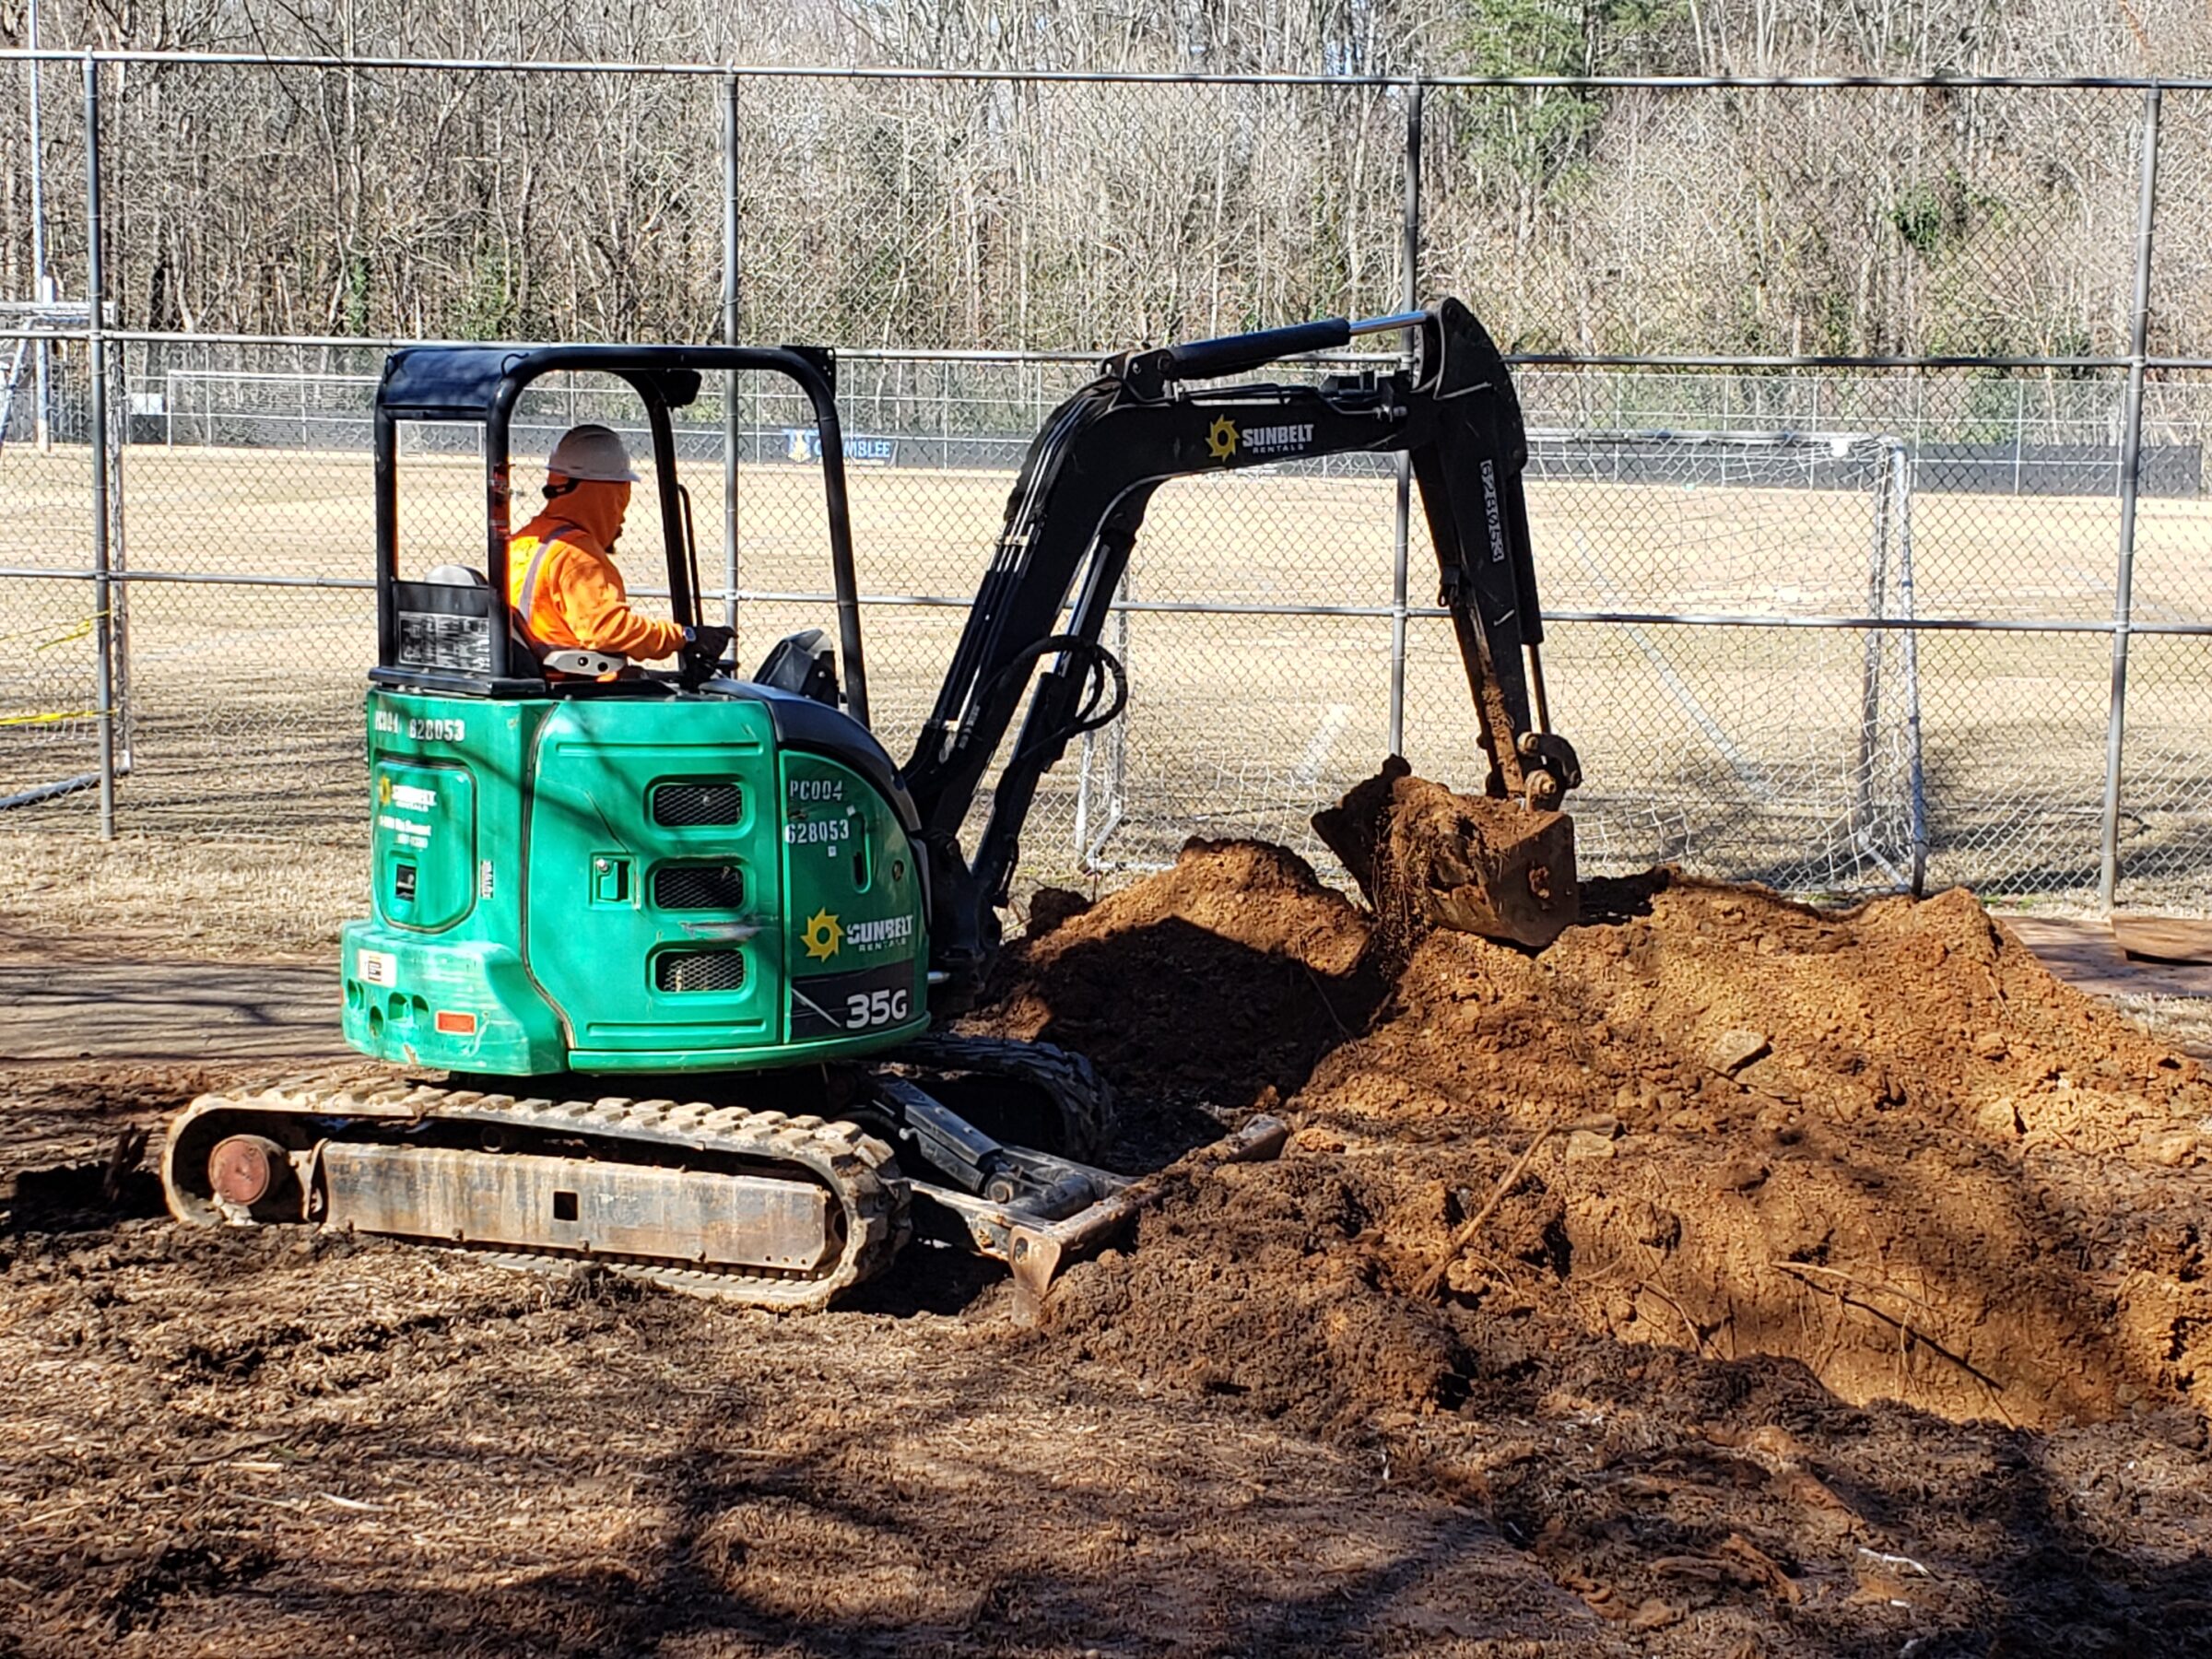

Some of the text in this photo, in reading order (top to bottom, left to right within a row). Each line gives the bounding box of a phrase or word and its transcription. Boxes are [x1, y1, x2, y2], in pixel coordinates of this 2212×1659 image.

[1242, 424, 1314, 447] SUNBELT
[1253, 443, 1305, 453] RENTALS
[1480, 462, 1504, 561] 628053
[409, 718, 465, 741] 628053
[790, 780, 842, 801] PC004
[784, 819, 849, 843] 628053
[846, 914, 913, 945] SUNBELT
[858, 938, 907, 952] RENTALS
[846, 989, 908, 1030] 35G
